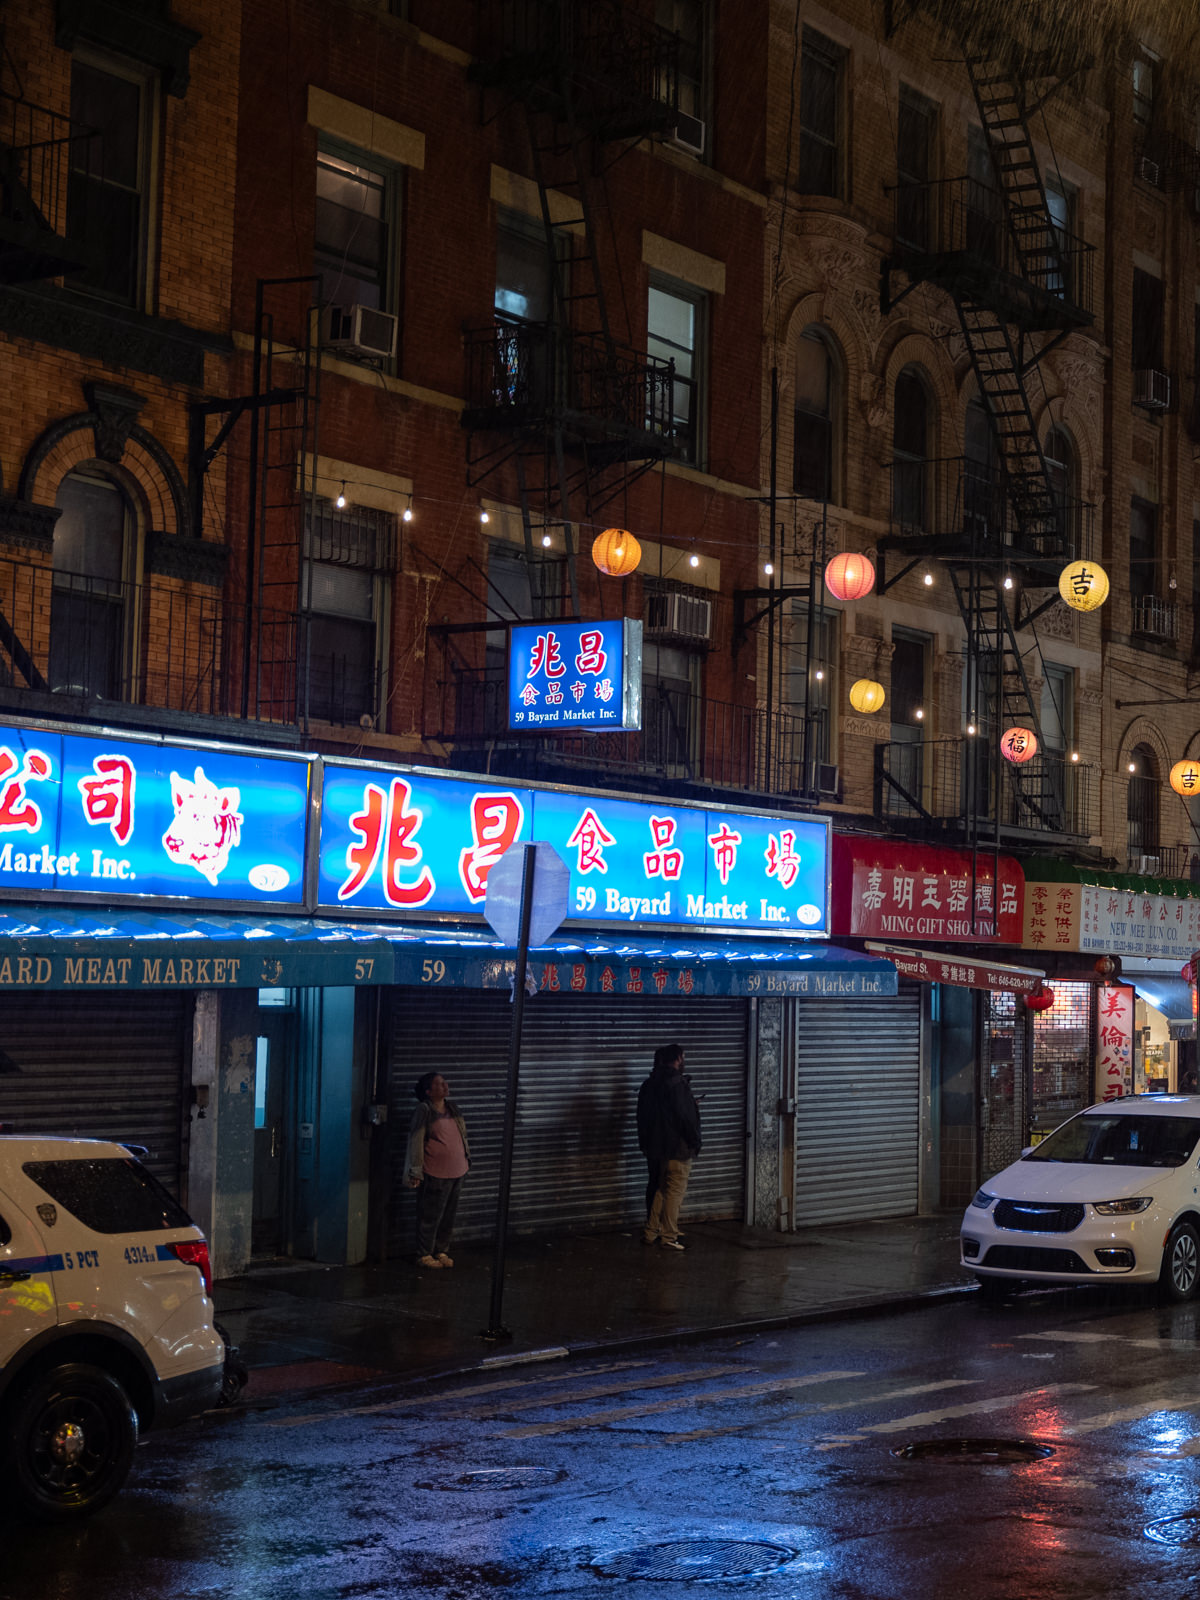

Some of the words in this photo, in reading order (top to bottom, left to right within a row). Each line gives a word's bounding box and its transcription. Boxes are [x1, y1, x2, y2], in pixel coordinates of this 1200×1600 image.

[1070, 568, 1094, 596] 吉
[527, 630, 608, 679] 兆昌
[519, 678, 614, 706] 食品市場
[515, 712, 524, 722] 59
[528, 710, 559, 723] Bayard
[563, 709, 595, 721] Market
[600, 708, 616, 719] Inc.
[1008, 733, 1024, 753] 福
[1181, 769, 1199, 789] 吉
[567, 807, 801, 890] 食品市場
[91, 849, 136, 881] Inc.
[576, 886, 596, 911] 59
[605, 888, 671, 921] Bayard
[686, 894, 748, 921] Market
[760, 899, 790, 922] Inc.
[862, 868, 1018, 915] 嘉明玉器禮品
[880, 914, 915, 934] MING
[916, 917, 945, 935] GIFT
[1029, 886, 1049, 944] 零售批發
[1110, 922, 1127, 936] NEW
[1130, 923, 1145, 938] MEE
[1149, 925, 1164, 940] LUN
[1167, 927, 1178, 941] CO.
[64, 957, 131, 985] MEAT
[142, 957, 240, 985] MARKET
[354, 958, 375, 980] 57
[421, 959, 446, 983] 59
[540, 964, 694, 994] 兆昌食品市場
[895, 959, 918, 973] Bayard
[919, 962, 929, 974] St.
[748, 974, 761, 992] 59
[766, 975, 808, 994] Bayard
[814, 976, 855, 993] Market
[861, 977, 882, 992] Inc.
[65, 1252, 73, 1269] 5
[76, 1250, 99, 1268] PCT
